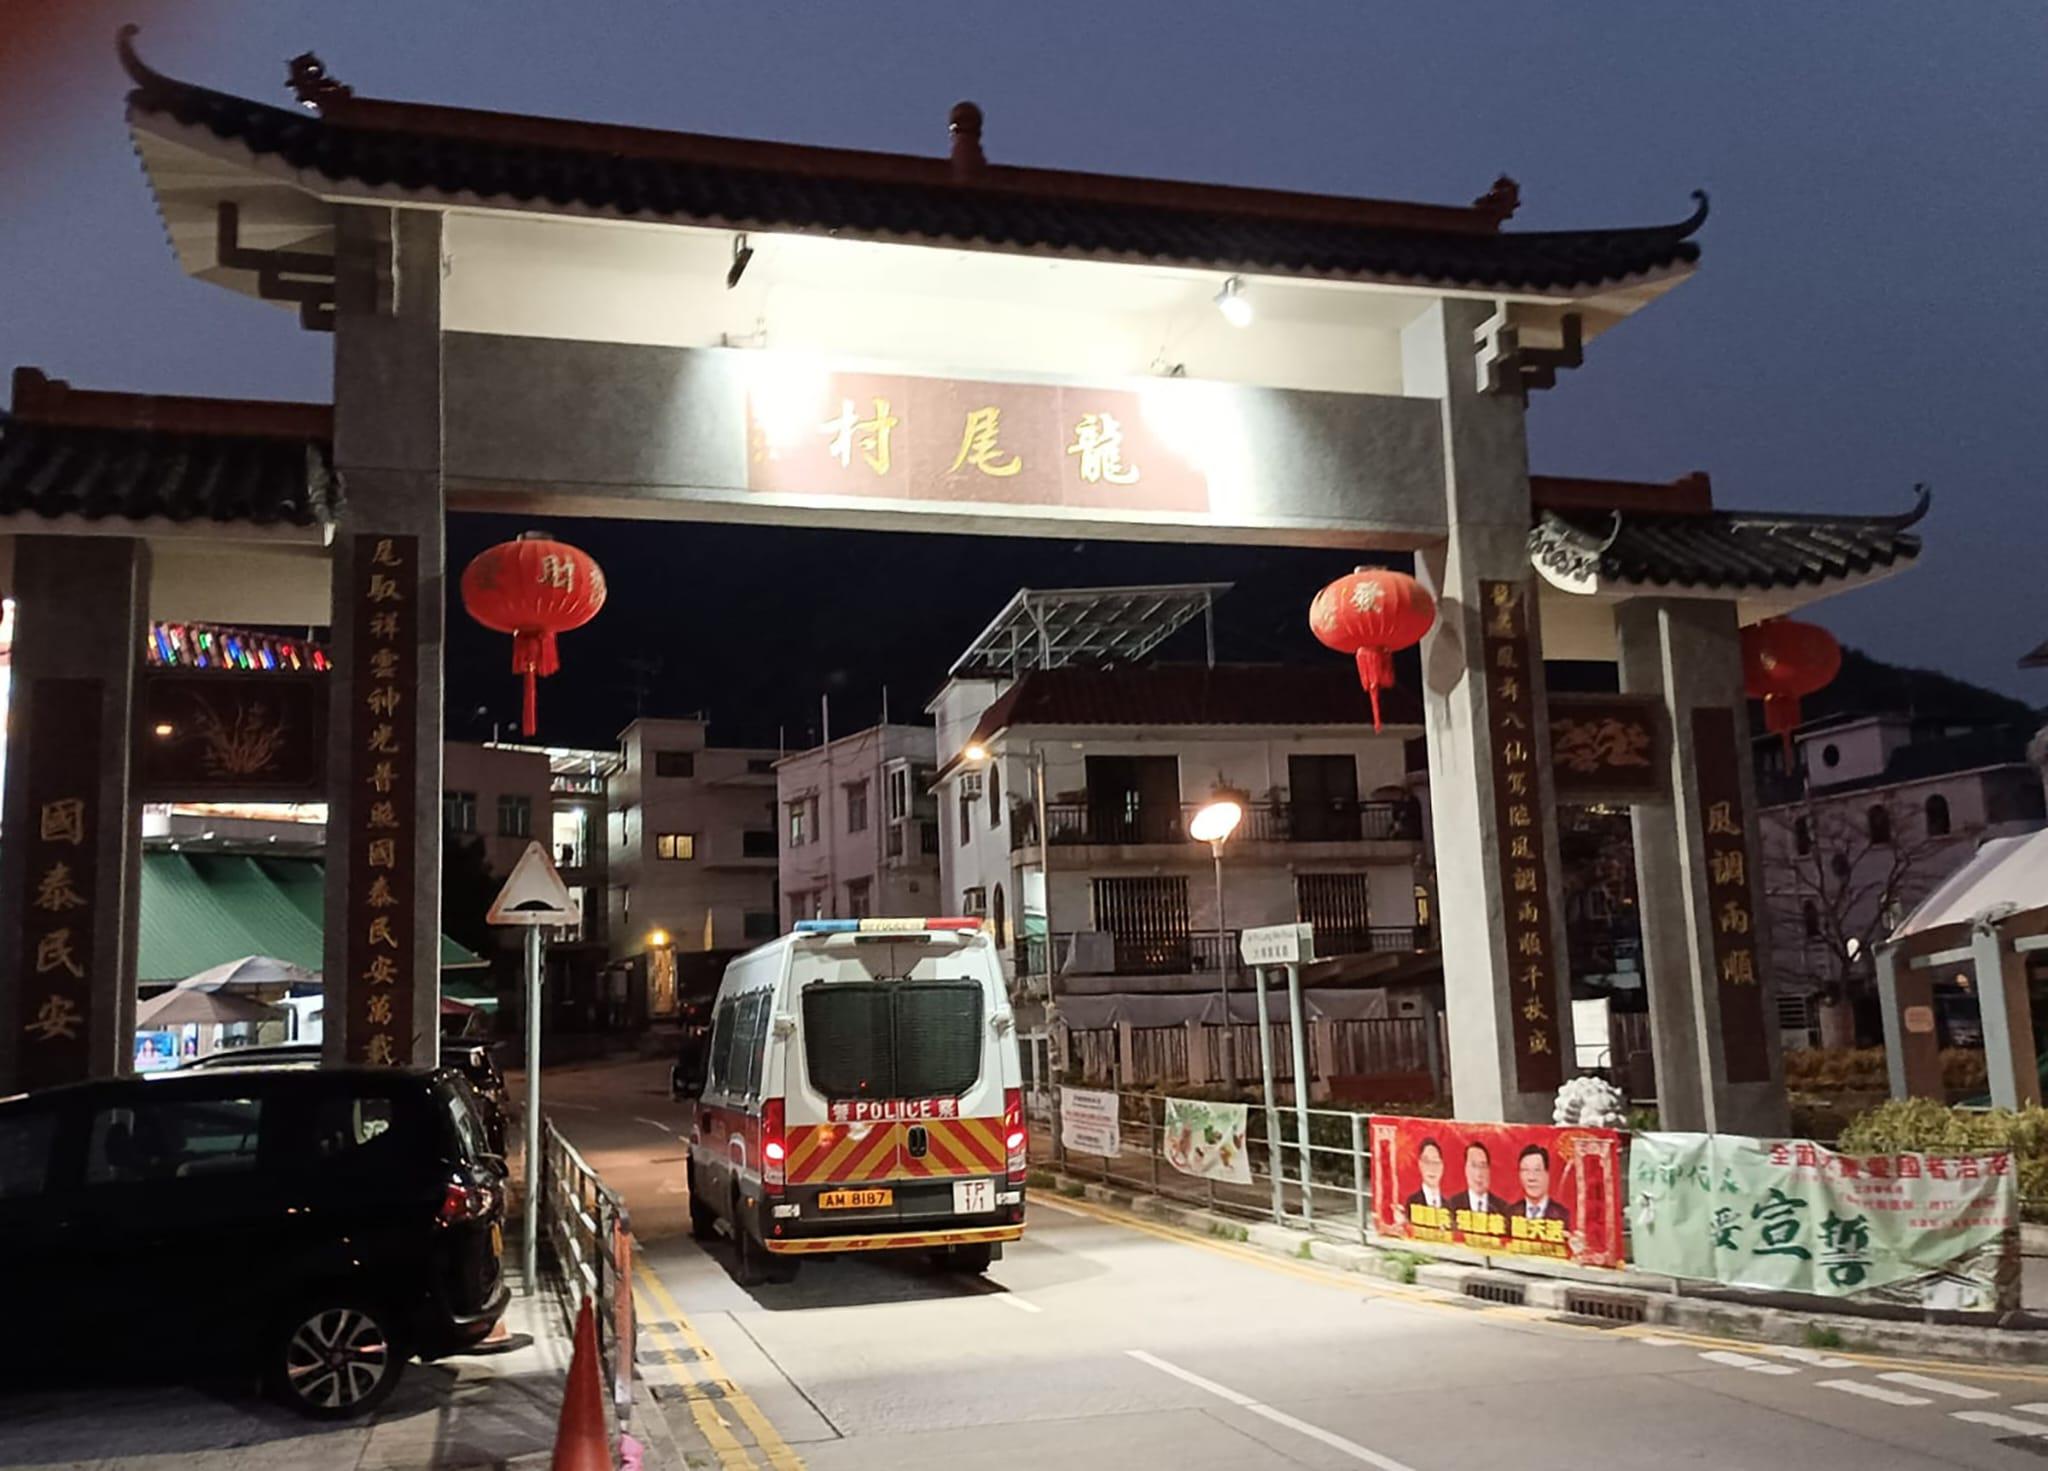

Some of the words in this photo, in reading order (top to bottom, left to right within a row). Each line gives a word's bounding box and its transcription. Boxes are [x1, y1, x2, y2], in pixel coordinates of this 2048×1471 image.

[1707, 800, 1757, 986] 風調雨順
[24, 798, 89, 1041] 國泰民安
[855, 1099, 933, 1121] POLICE
[964, 1183, 985, 1195] TP
[825, 1195, 845, 1207] AM
[850, 1192, 886, 1206] 8187
[965, 1196, 985, 1212] 1/1
